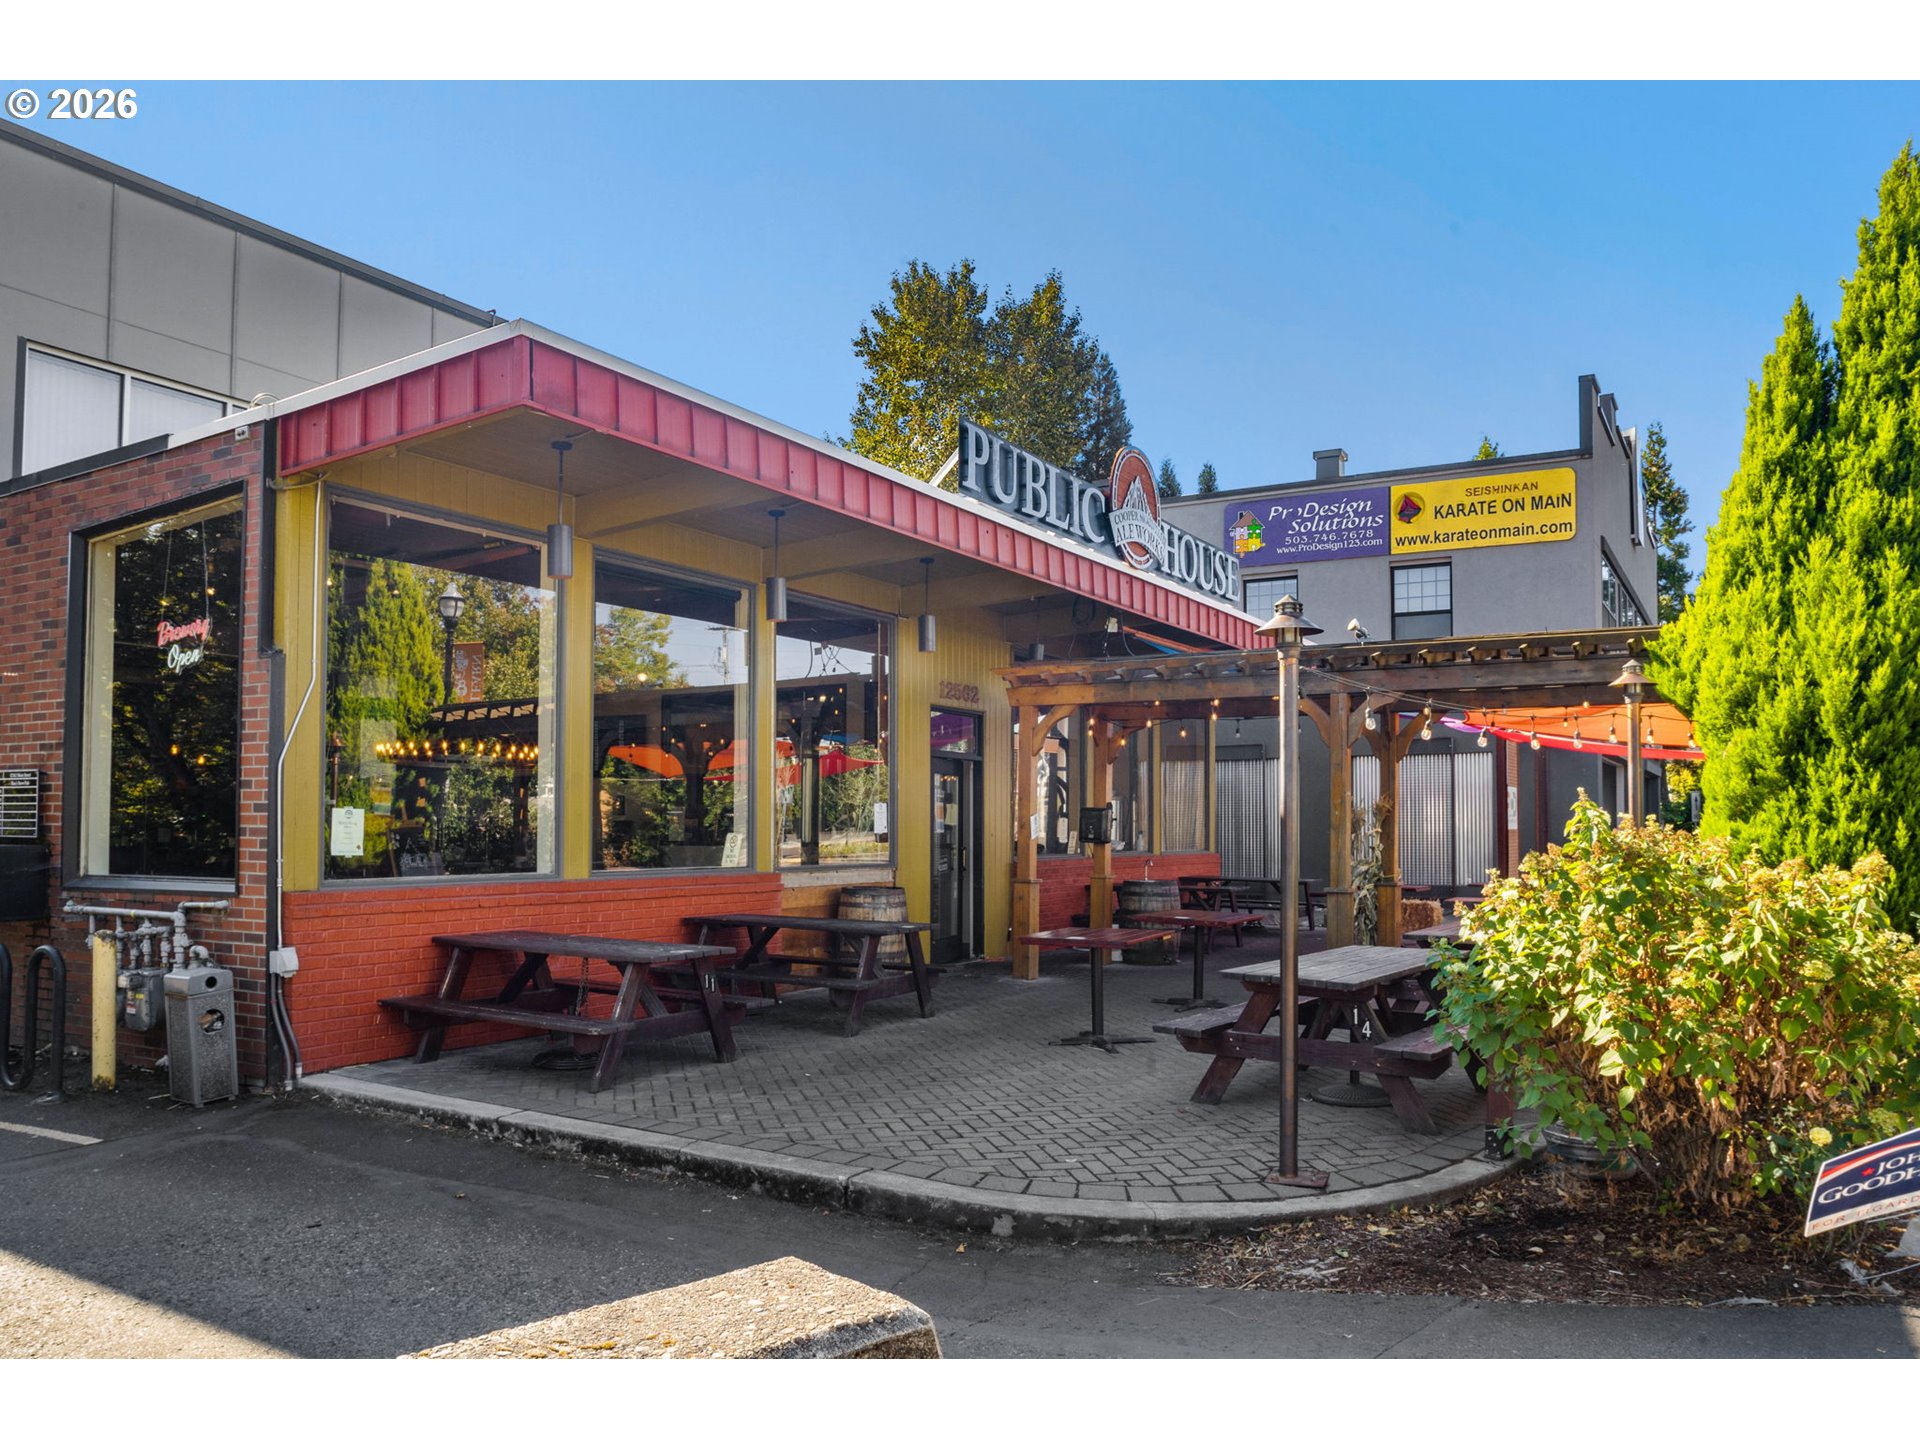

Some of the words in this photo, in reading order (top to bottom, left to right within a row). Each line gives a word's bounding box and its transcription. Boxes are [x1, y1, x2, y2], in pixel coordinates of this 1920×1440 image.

[1465, 481, 1539, 497] SEISHINKAN
[962, 420, 1106, 544] PUBLIC
[1161, 519, 1240, 601] HOUSE
[1434, 500, 1497, 520] KARATE
[1502, 497, 1525, 513] ON
[1531, 492, 1572, 511] MAIN
[1287, 513, 1384, 534] Solutions
[1395, 521, 1573, 547] www.karateonmain.com
[1276, 538, 1383, 554] www.ProDesign123.com
[1284, 529, 1374, 545] 503.746.7678
[167, 644, 200, 673] Open
